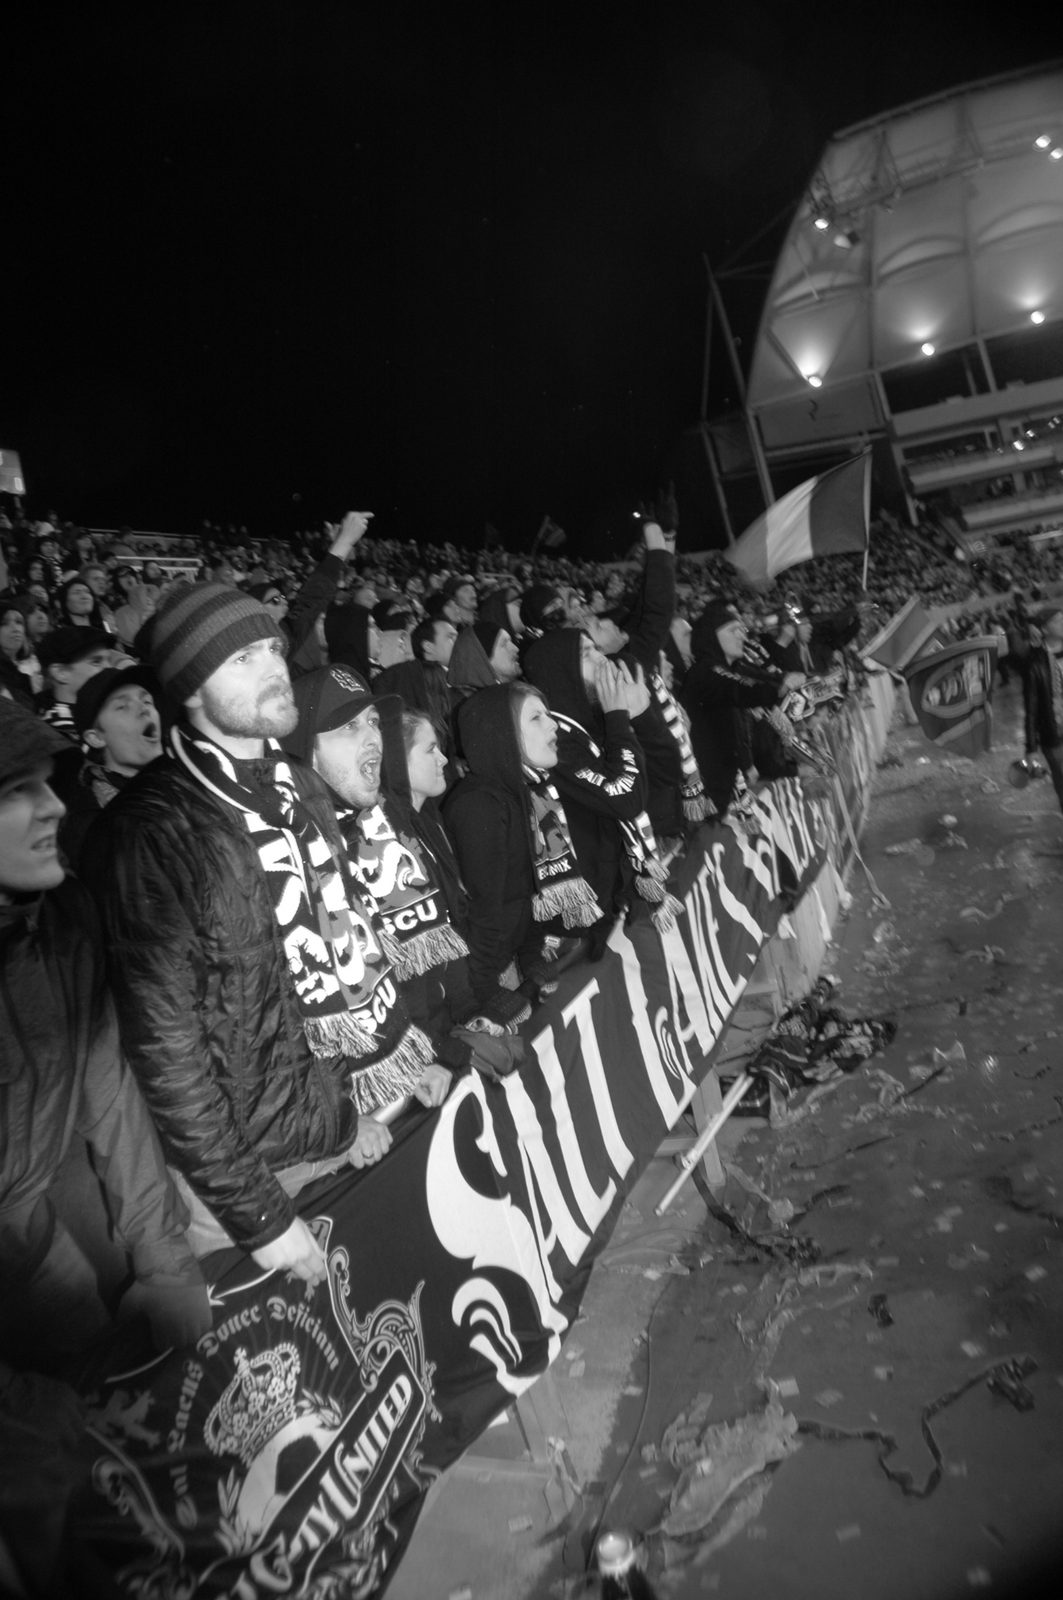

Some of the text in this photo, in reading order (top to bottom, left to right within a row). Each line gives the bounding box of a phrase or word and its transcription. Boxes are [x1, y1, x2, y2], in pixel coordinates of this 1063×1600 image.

[355, 977, 398, 1035] SCU
[425, 978, 635, 1398] SALT
[607, 842, 768, 1130] LAKE'S
[196, 1302, 261, 1357] Donec
[266, 1296, 340, 1371] Deficiam
